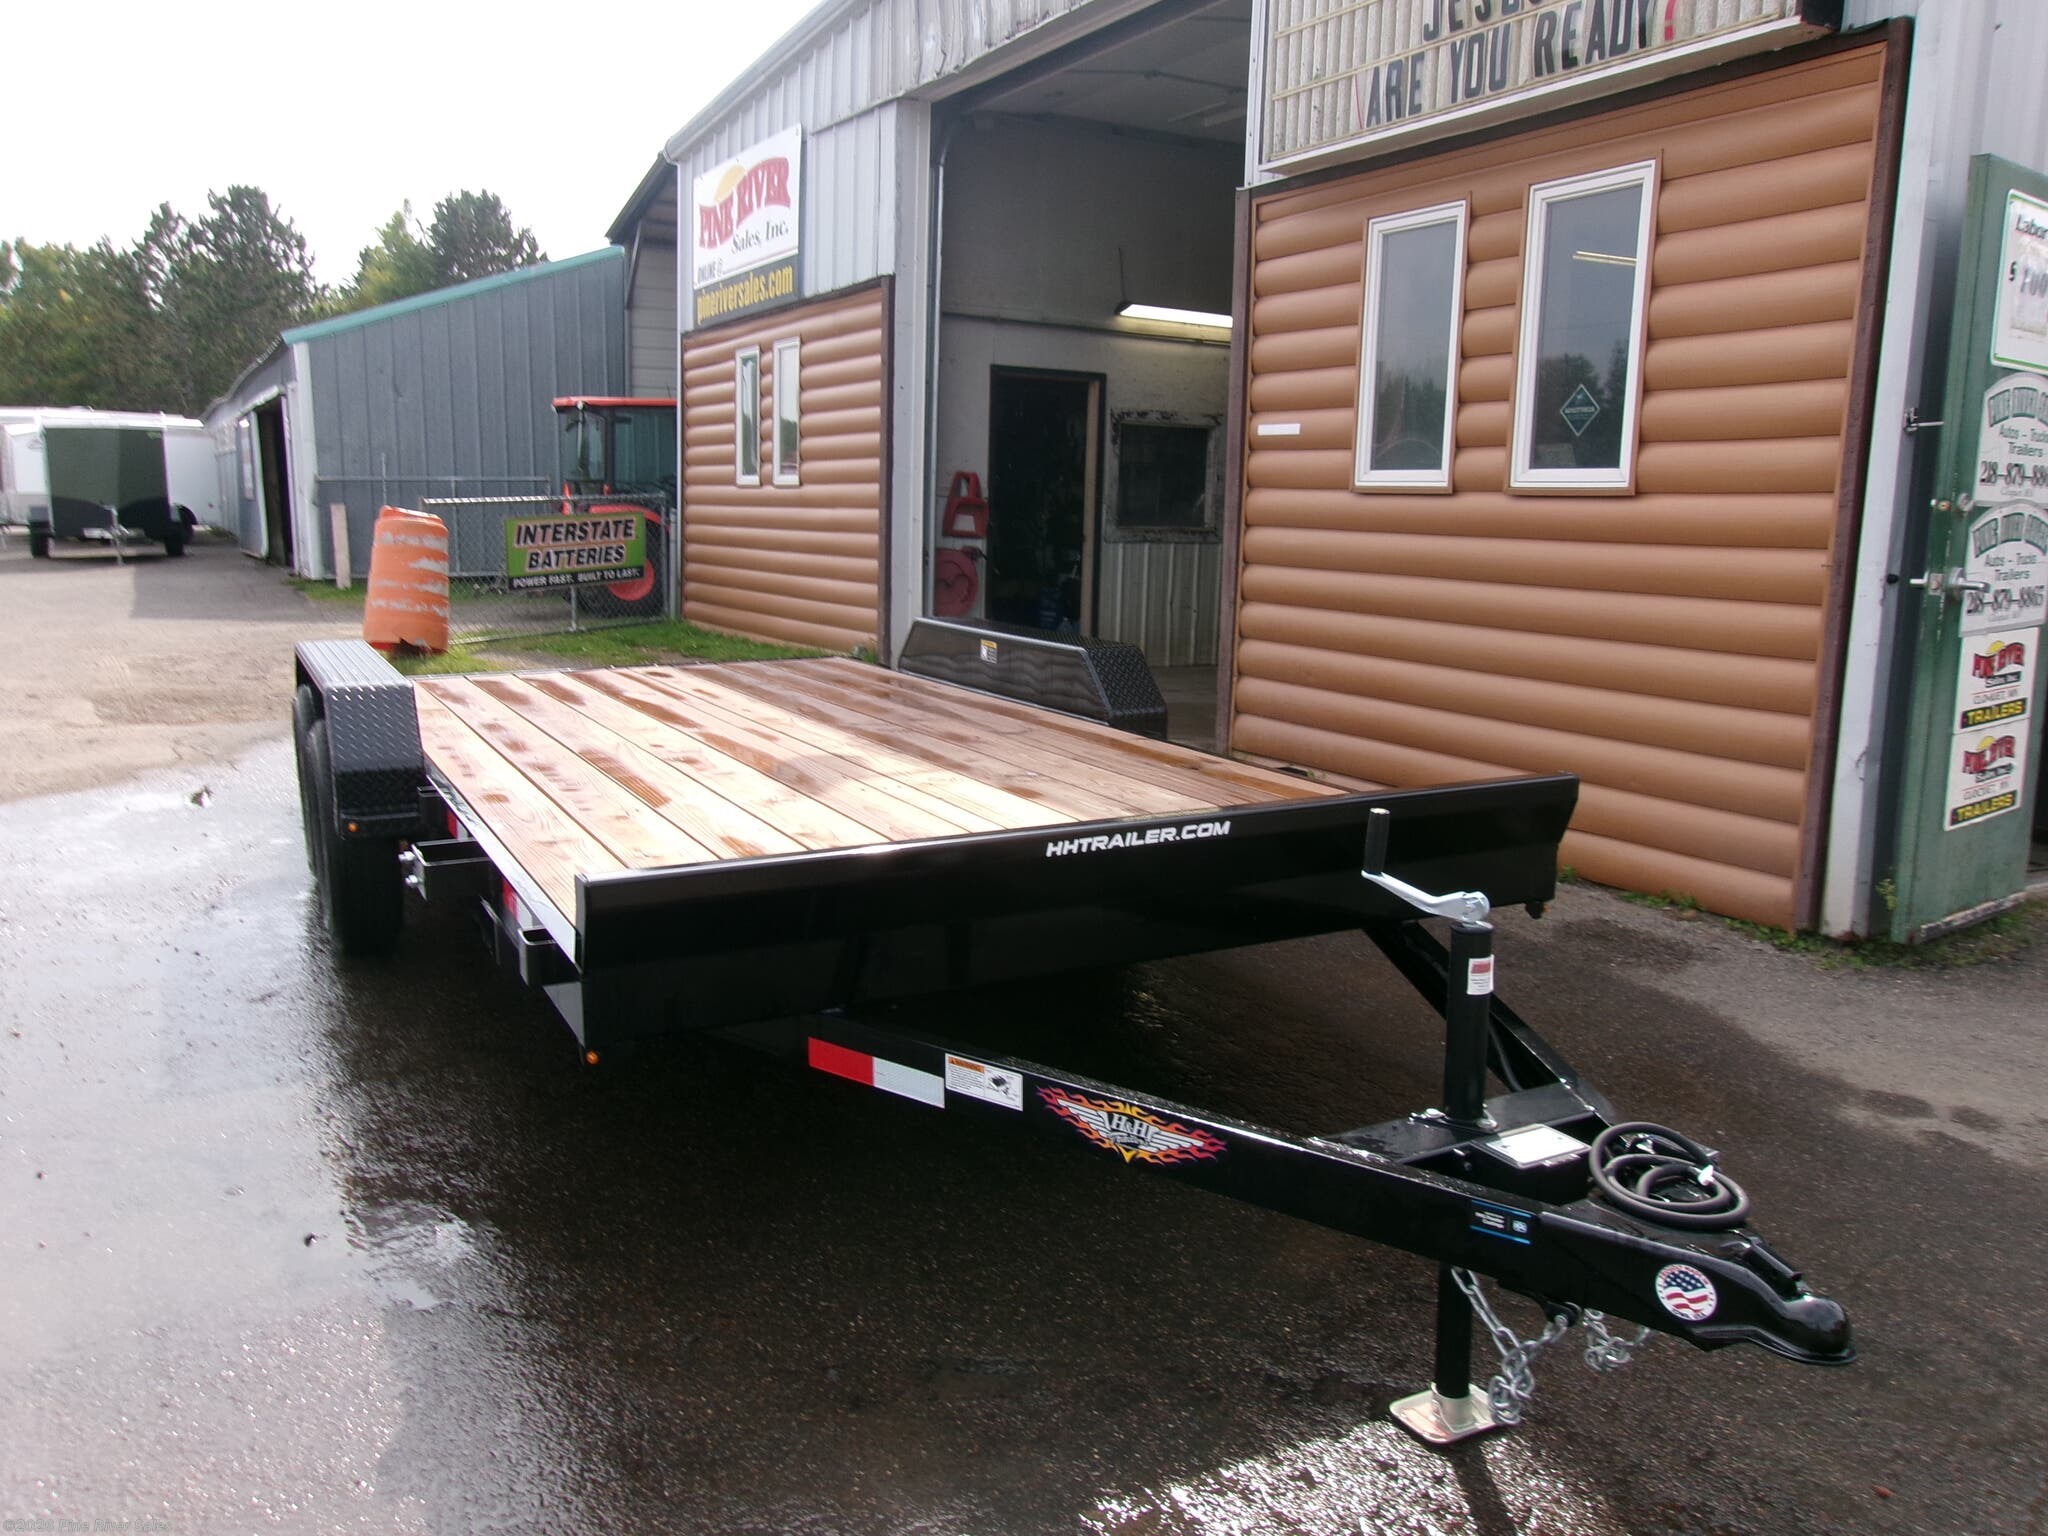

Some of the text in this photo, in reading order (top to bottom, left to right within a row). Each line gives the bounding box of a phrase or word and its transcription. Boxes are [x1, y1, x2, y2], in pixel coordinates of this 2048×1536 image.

[1366, 52, 1425, 129] ARE
[1451, 23, 1512, 104] YOU
[699, 156, 791, 249] PINE RIVER
[515, 518, 636, 546] INTERSTATE
[527, 544, 627, 571] BATTERIES
[512, 576, 547, 589] POWER
[1966, 700, 2025, 726] TRAILERS
[1956, 793, 2015, 821] TRAILERS
[1045, 820, 1232, 858] HHTRAILER.COM
